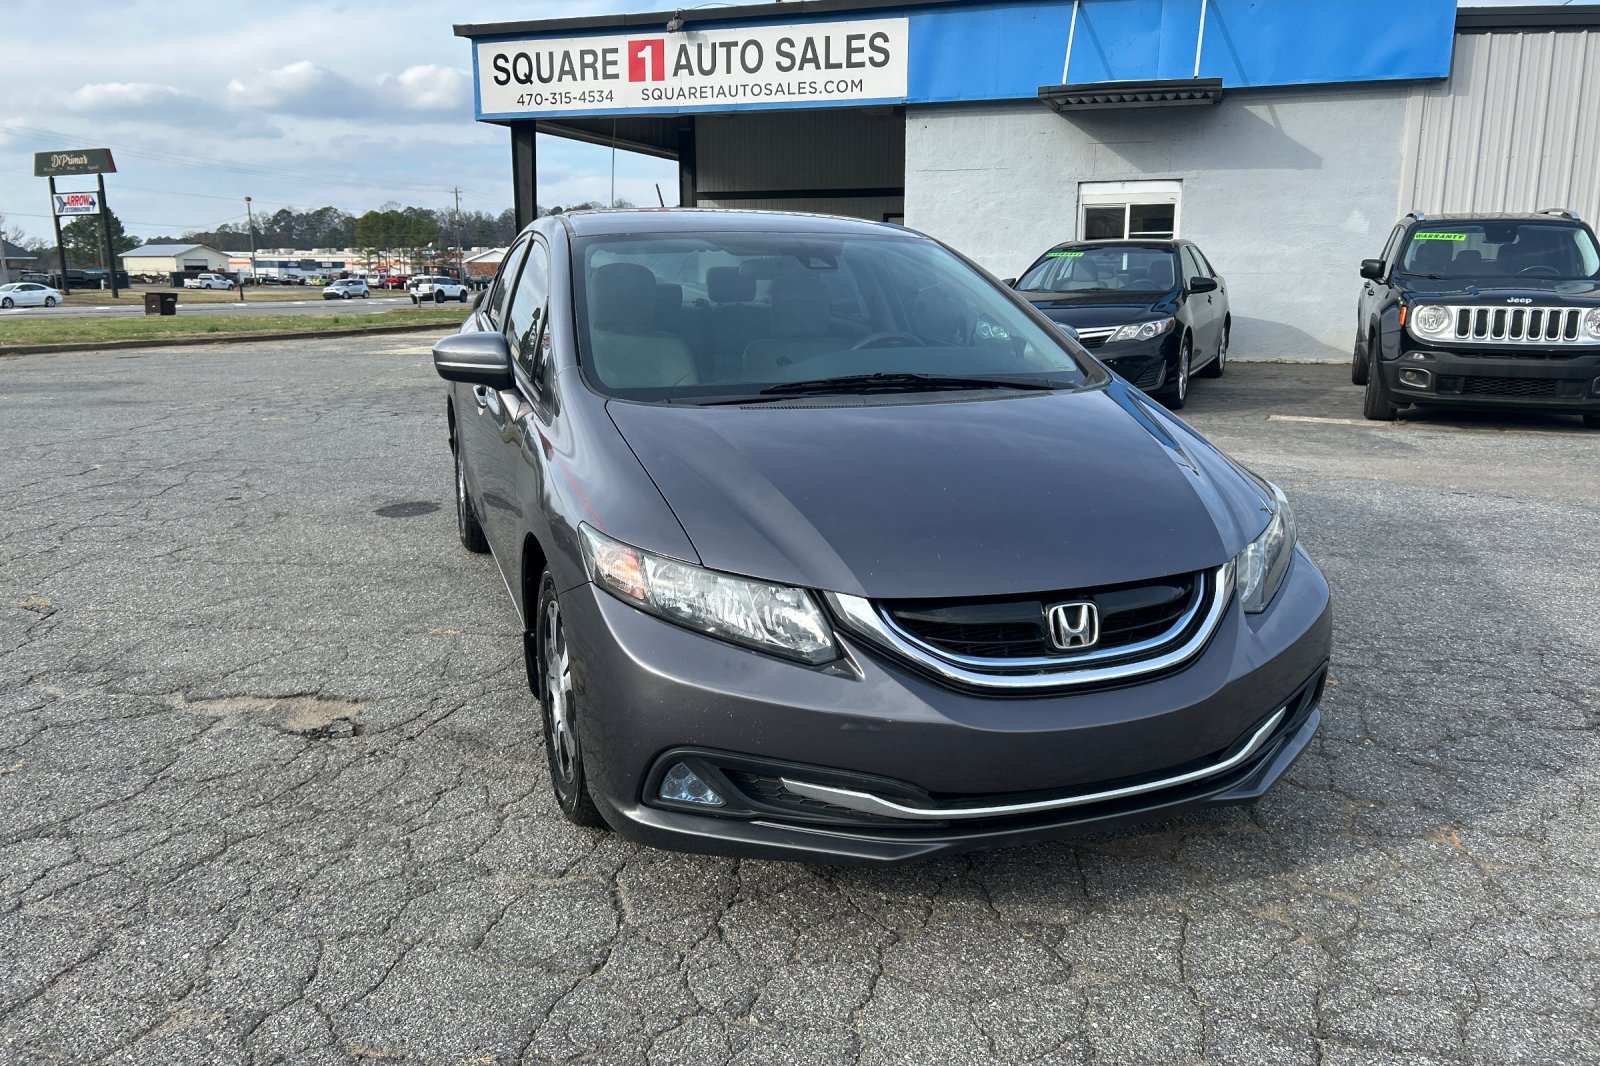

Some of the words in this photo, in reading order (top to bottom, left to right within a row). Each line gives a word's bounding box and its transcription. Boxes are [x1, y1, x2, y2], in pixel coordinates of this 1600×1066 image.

[493, 48, 619, 85] SQUARE
[637, 45, 653, 82] 1
[672, 39, 764, 77] AUTO
[775, 32, 890, 72] SALES
[517, 89, 614, 106] 470-315-4534
[641, 79, 863, 101] SQUARE1AUTOSALES.COM
[66, 194, 90, 206] ARROW
